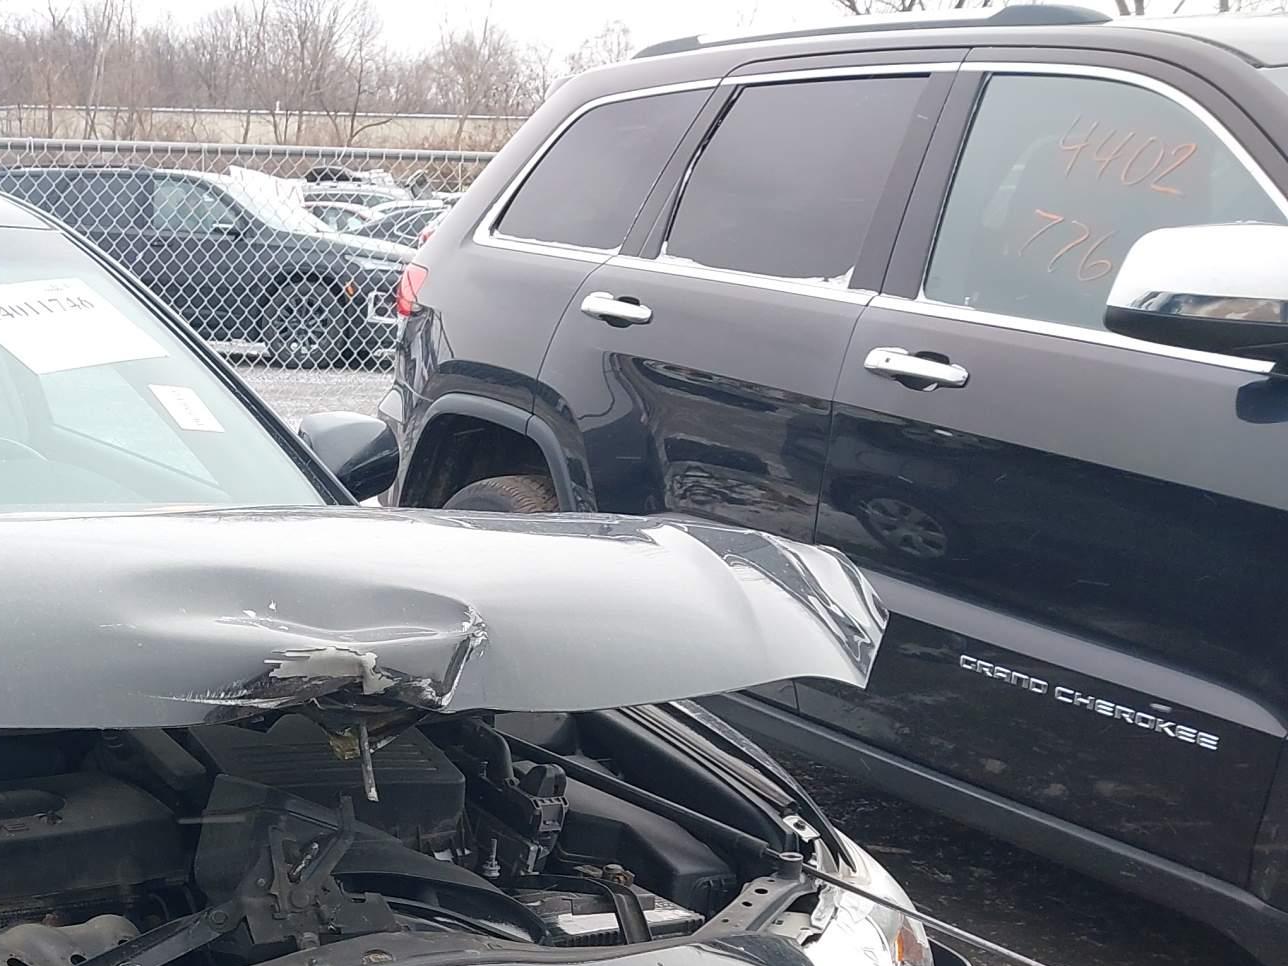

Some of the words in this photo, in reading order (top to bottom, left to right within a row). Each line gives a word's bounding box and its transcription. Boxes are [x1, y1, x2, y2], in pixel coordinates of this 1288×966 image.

[1058, 114, 1198, 197] 4402
[1018, 208, 1118, 281] 776
[959, 653, 1049, 695] GRAND
[1054, 685, 1221, 751] CHEROKEE
